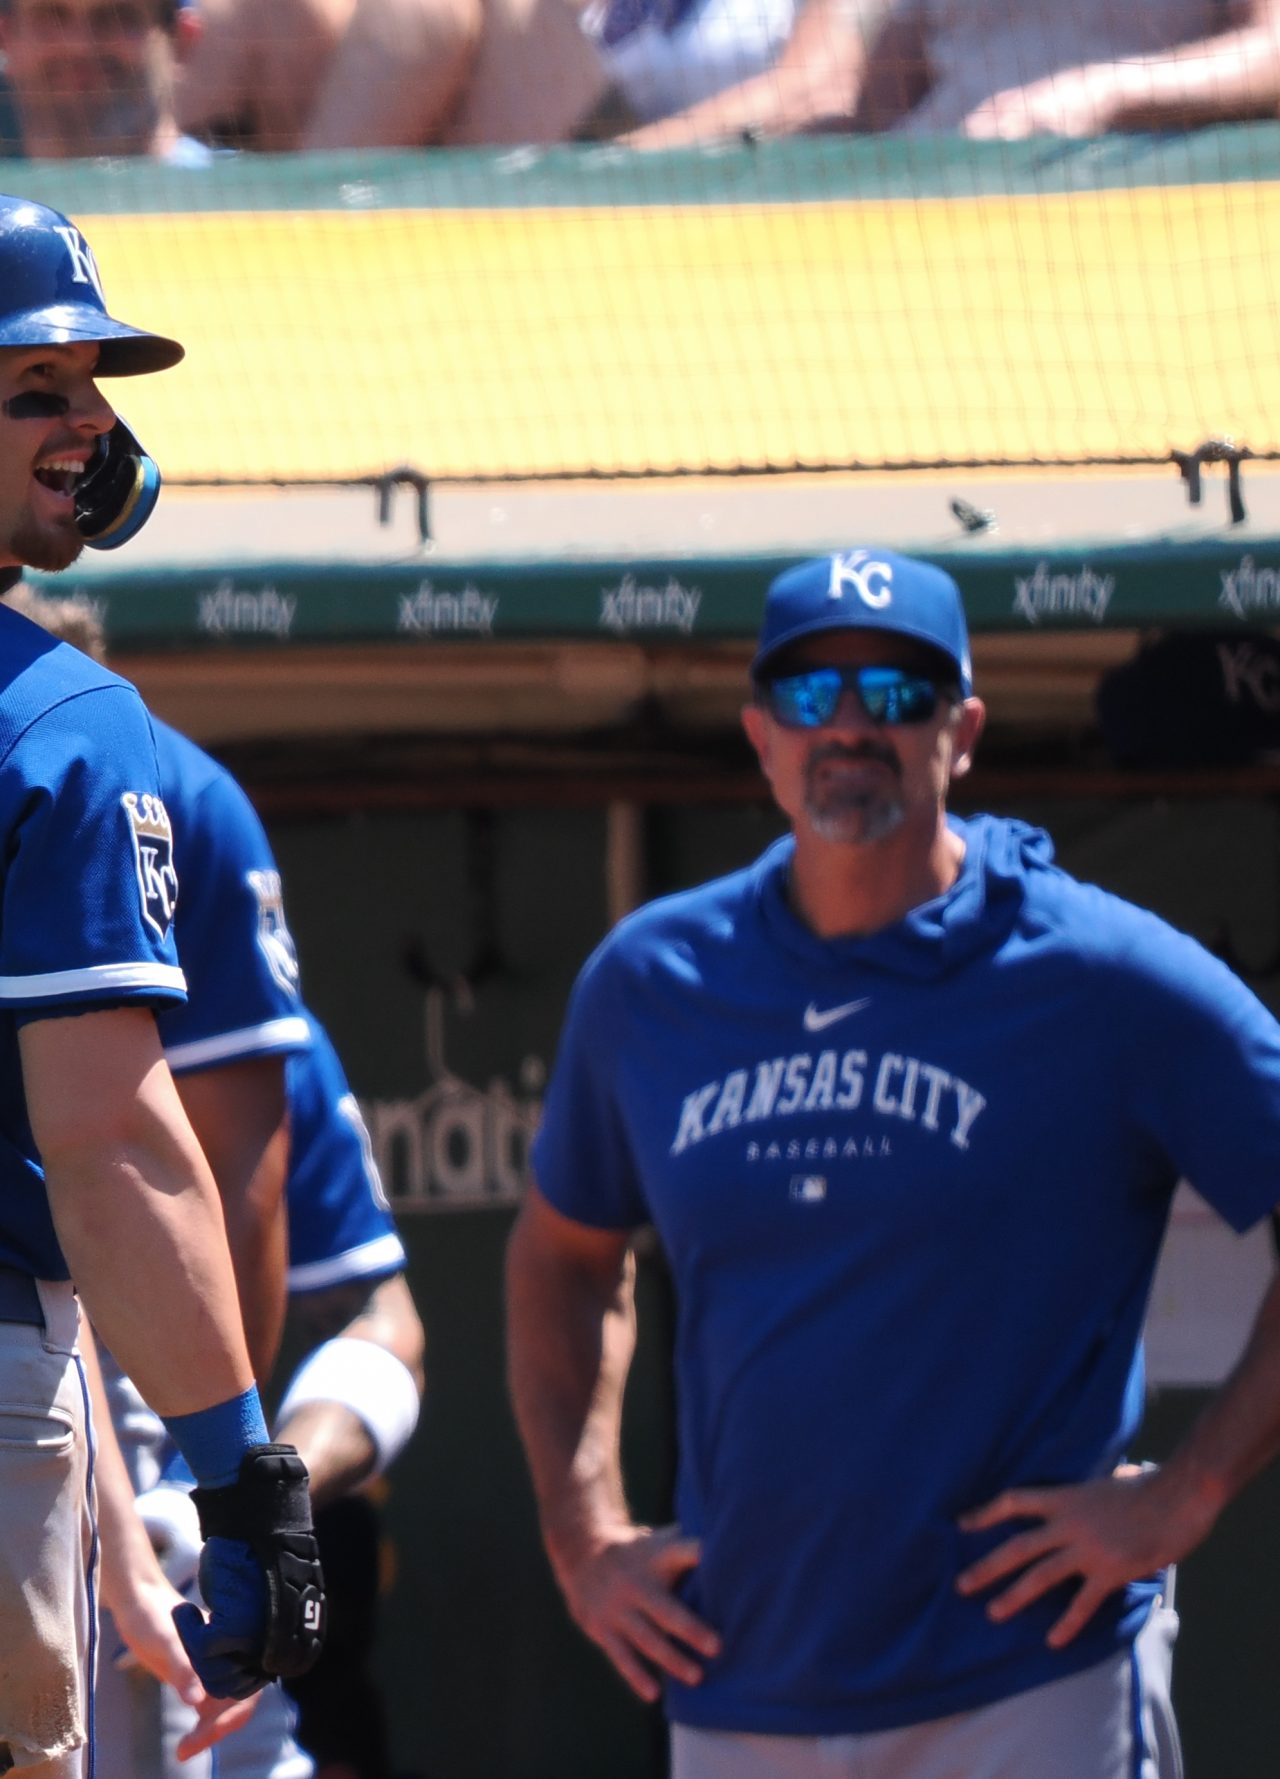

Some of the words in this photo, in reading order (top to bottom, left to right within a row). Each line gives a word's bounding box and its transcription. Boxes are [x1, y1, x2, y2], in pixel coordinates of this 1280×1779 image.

[397, 579, 500, 638] xfinity
[599, 574, 702, 634] xfinity
[827, 550, 893, 609] KC
[1014, 562, 1116, 624] xfinity
[196, 581, 298, 638] xfinity
[671, 1049, 868, 1156] KANSAS
[873, 1052, 988, 1151] CITY
[745, 1136, 893, 1162] BASEBALL
